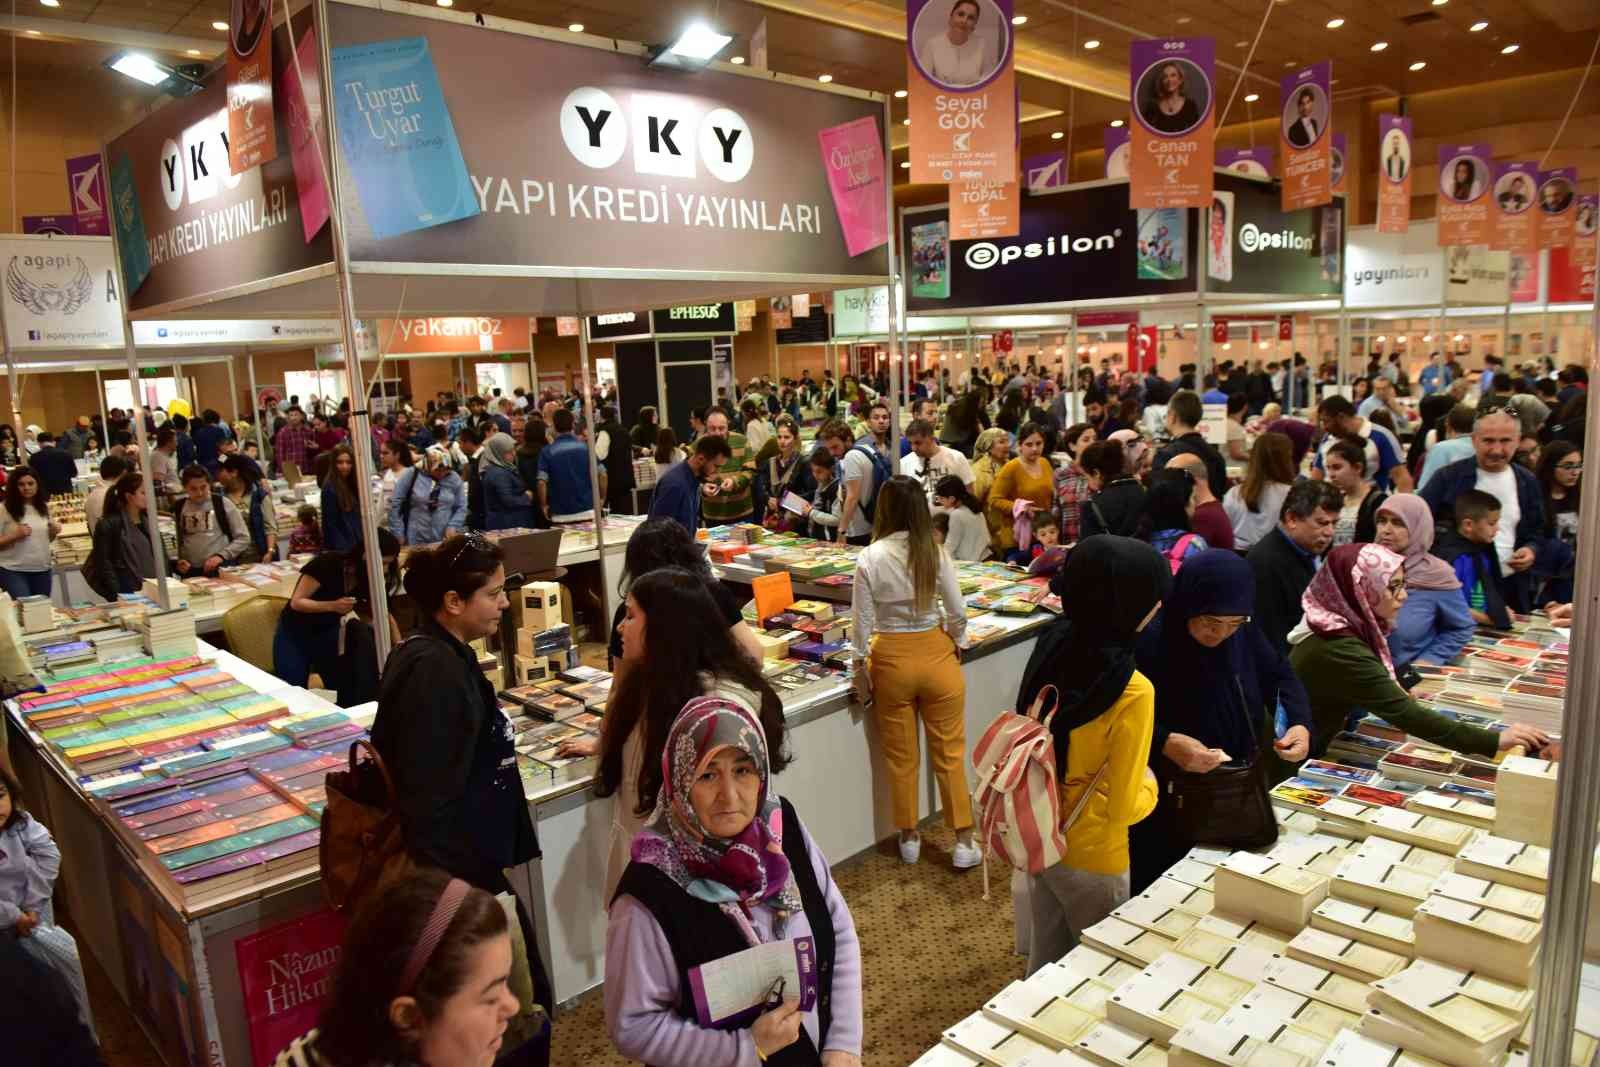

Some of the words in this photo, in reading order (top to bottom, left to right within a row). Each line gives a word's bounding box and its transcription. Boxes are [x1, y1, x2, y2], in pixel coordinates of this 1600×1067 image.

[344, 80, 421, 115] Turgut
[935, 95, 988, 112] Seyal
[365, 111, 422, 147] Uyar
[938, 111, 986, 130] GÖK
[1147, 140, 1198, 153] Canan
[1154, 153, 1189, 168] TAN
[471, 175, 556, 217] YAPI
[567, 183, 670, 225] KREDİ
[675, 192, 823, 235] YAYINLARI
[960, 189, 1008, 204] TOPAL
[168, 210, 208, 259] KREDİ
[208, 185, 288, 246] YAYINLARI
[1239, 222, 1313, 253] epsilon
[24, 254, 72, 269] agapi
[965, 233, 1115, 270] epsilon
[669, 304, 720, 320] EPHESUS
[400, 317, 504, 342] yakamoz
[264, 970, 334, 1016] Hikm
